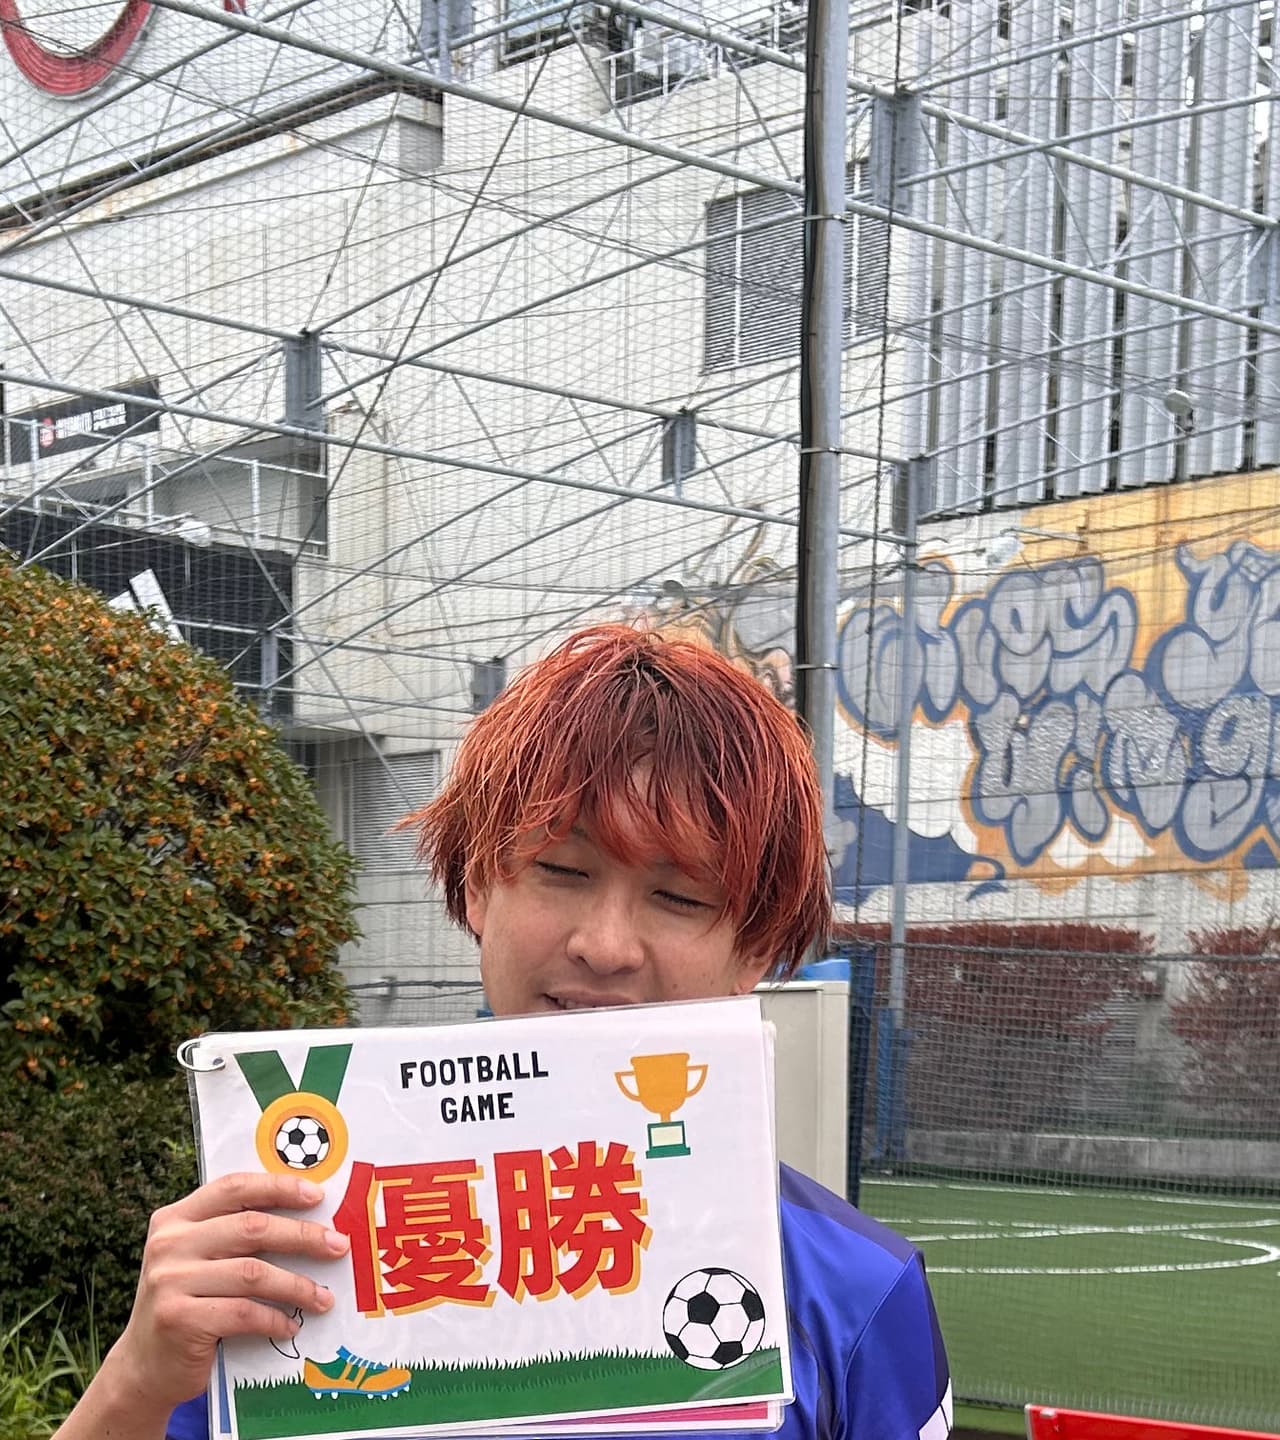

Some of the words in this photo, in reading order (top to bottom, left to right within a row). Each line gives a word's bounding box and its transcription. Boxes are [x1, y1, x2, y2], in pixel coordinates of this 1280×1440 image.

[400, 1051, 549, 1089] FOOTBALL
[439, 1092, 516, 1125] GAME
[333, 1141, 652, 1318] 優勝
